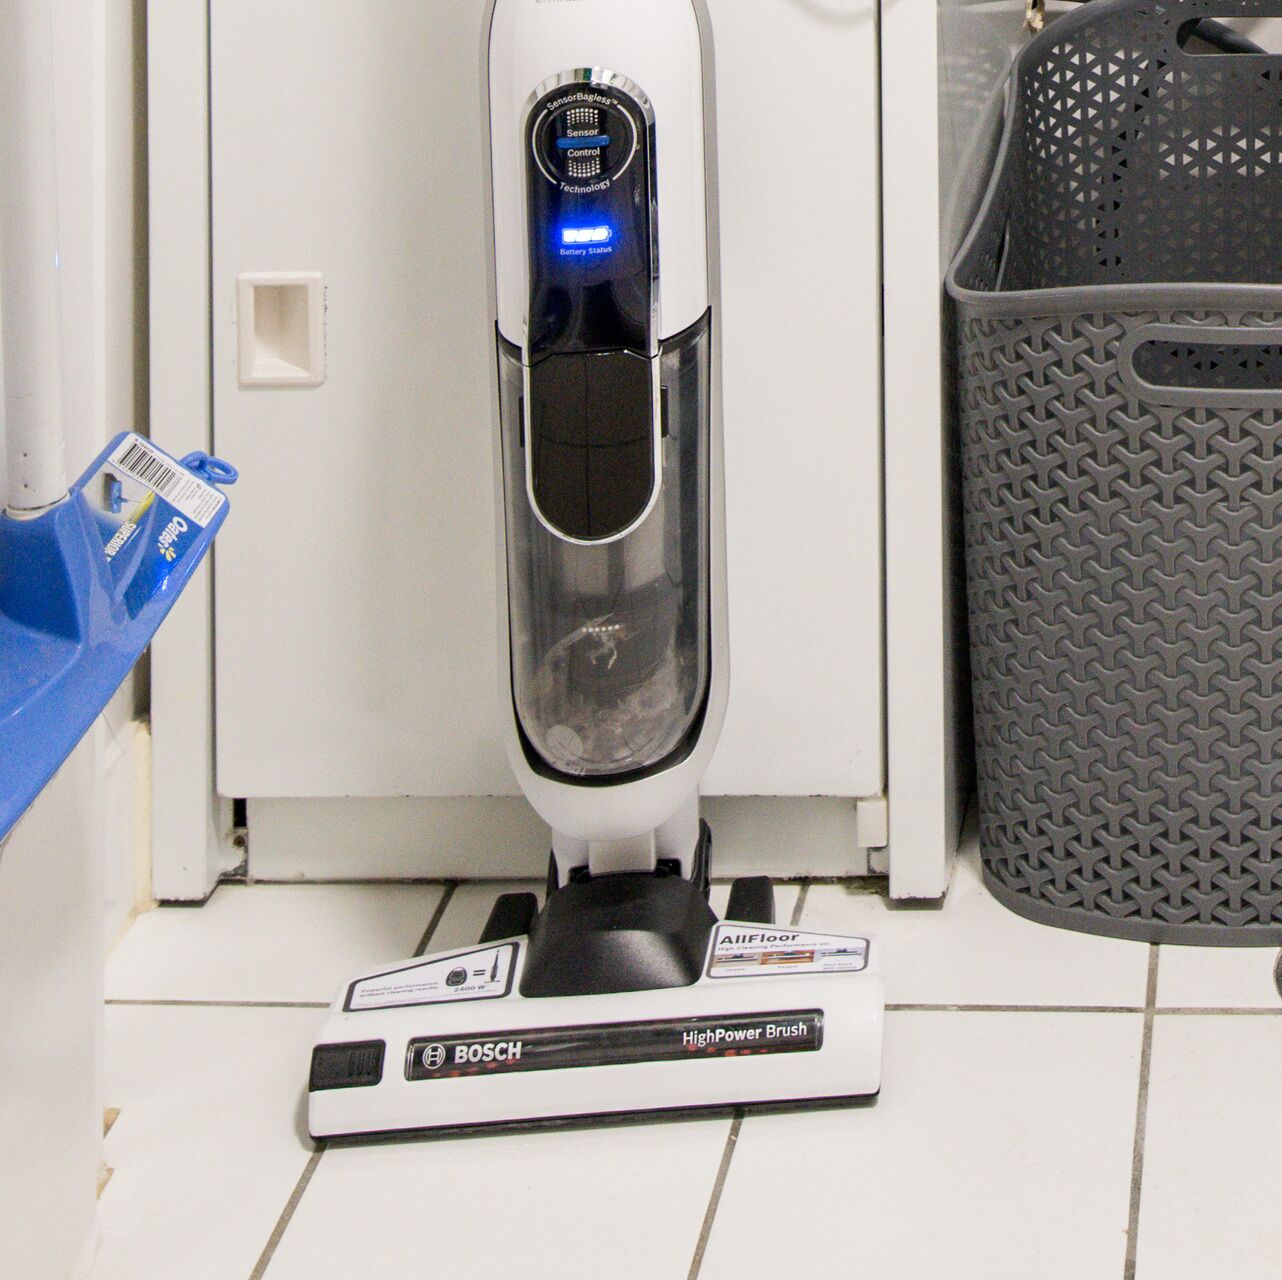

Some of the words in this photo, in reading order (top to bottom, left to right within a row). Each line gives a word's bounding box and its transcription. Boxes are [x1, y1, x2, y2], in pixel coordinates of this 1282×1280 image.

[567, 128, 599, 137] Sensor
[567, 147, 600, 157] Control
[559, 179, 610, 194] Technology
[560, 247, 587, 256] Battery
[588, 245, 612, 254] Status
[104, 521, 137, 556] SUPERIOR
[159, 516, 188, 550] Oates
[720, 933, 800, 945] AllFloor
[682, 1025, 763, 1048] HighPower
[765, 1021, 808, 1041] Brush
[454, 1040, 523, 1064] BOSCH
